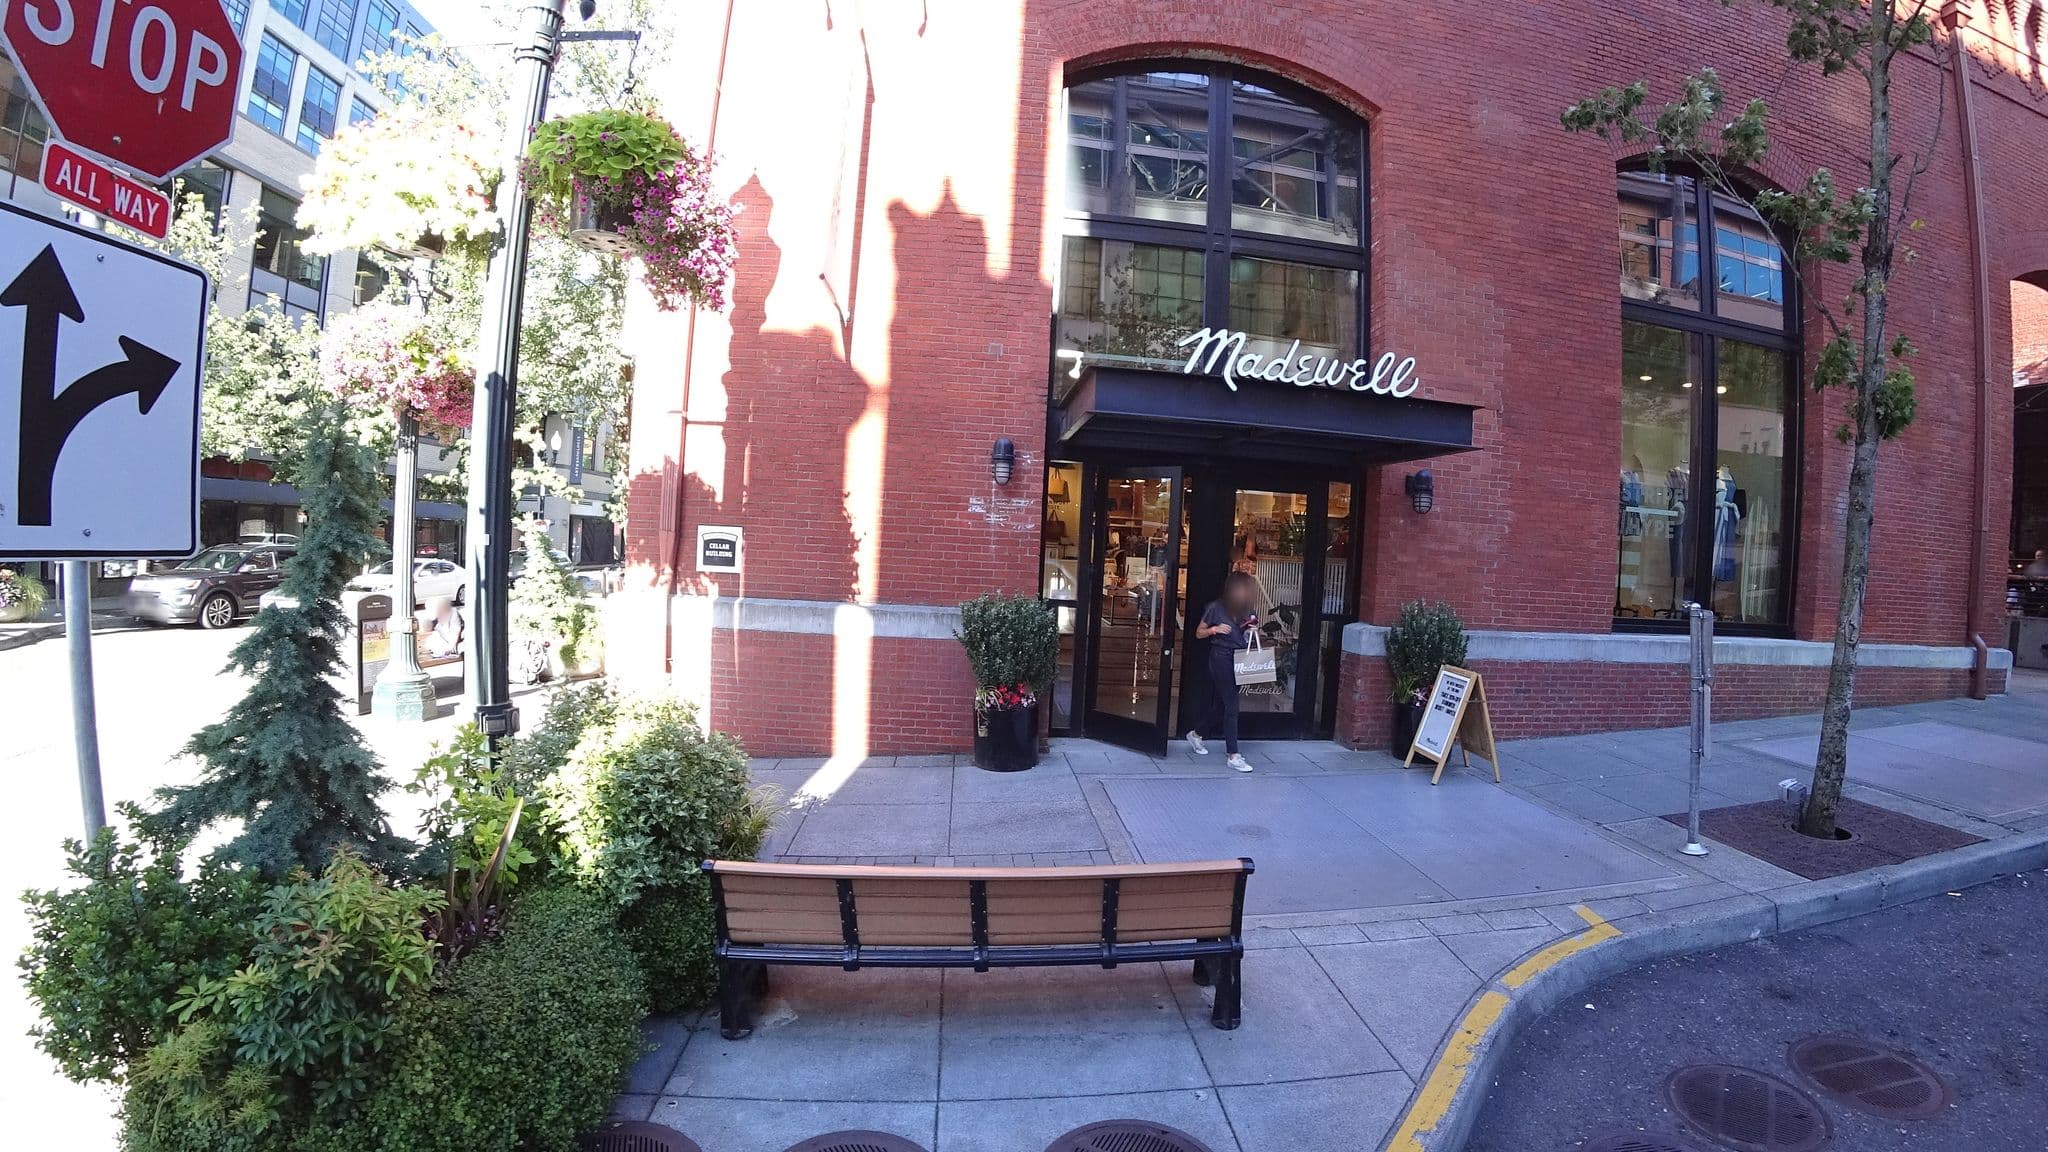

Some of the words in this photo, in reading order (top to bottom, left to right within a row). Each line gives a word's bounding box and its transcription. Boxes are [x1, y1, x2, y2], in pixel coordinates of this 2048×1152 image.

[23, 0, 228, 112] STOP
[55, 159, 101, 204] ALL
[114, 184, 160, 227] WAY
[1179, 327, 1419, 399] Madewell
[705, 550, 733, 558] BUILDING
[1239, 685, 1283, 696] Madewell
